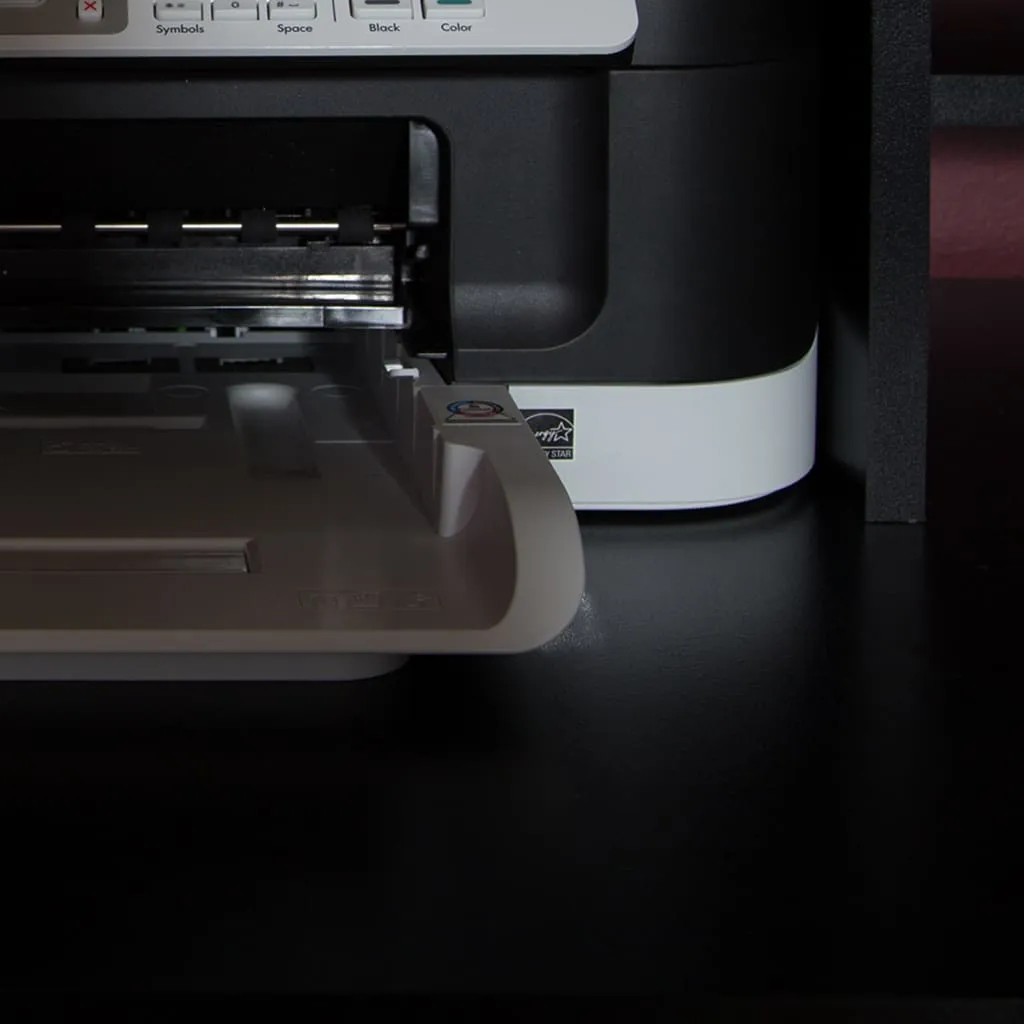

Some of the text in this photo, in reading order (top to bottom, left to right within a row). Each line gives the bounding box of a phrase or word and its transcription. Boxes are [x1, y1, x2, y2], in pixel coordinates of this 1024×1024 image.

[156, 24, 205, 36] Symbols
[277, 23, 313, 35] Space
[368, 23, 400, 33] Black
[440, 23, 472, 33] Color
[550, 449, 572, 457] STAR
